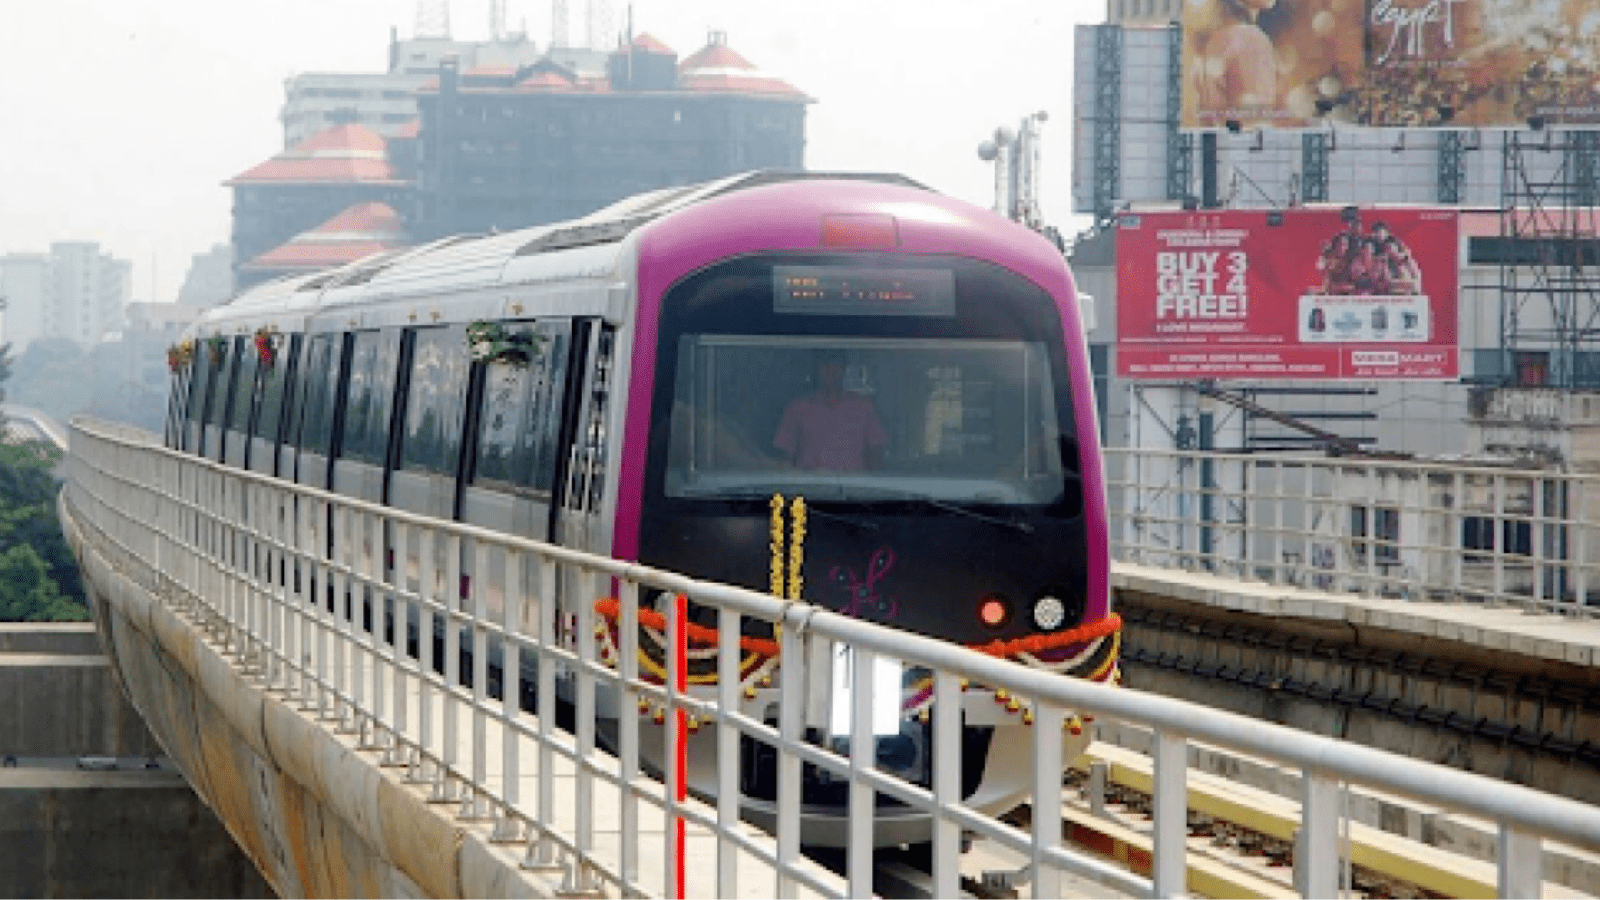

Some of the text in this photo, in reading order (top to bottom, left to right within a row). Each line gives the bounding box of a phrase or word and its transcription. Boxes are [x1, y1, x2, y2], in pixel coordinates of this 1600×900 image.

[1157, 252, 1246, 273] BUY 3
[1157, 272, 1246, 294] GET 4
[1157, 294, 1247, 318] FREE!
